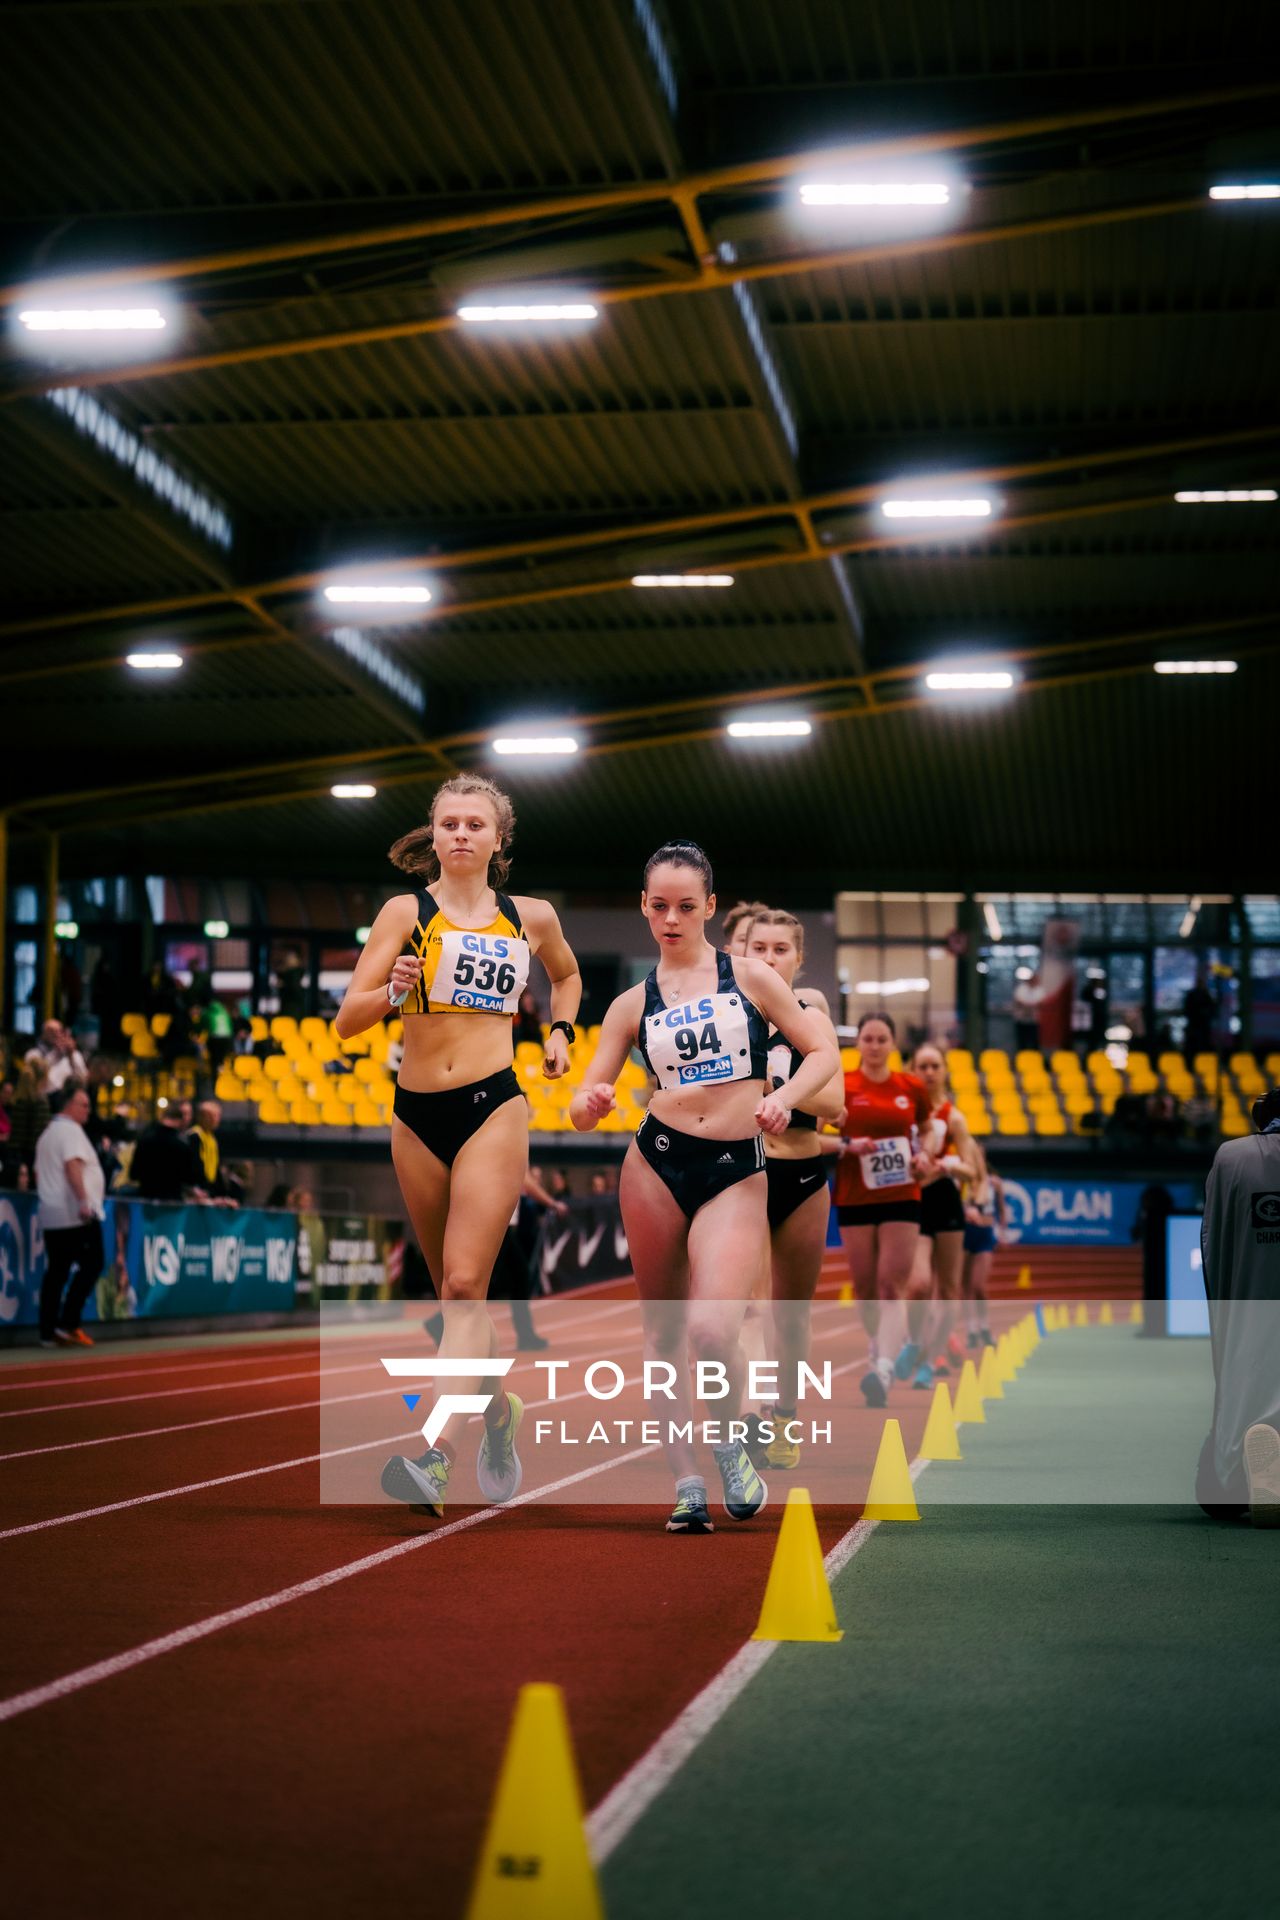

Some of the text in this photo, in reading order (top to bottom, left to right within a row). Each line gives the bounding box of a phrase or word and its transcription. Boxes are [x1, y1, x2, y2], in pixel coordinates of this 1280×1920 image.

[461, 934, 509, 958] GLS
[453, 953, 516, 995] 536
[475, 996, 503, 1011] PLAN
[665, 998, 715, 1028] GLS
[674, 1022, 722, 1061] 94
[700, 1060, 731, 1073] PLAN
[870, 1152, 905, 1173] 209
[1037, 1187, 1113, 1221] PLAN
